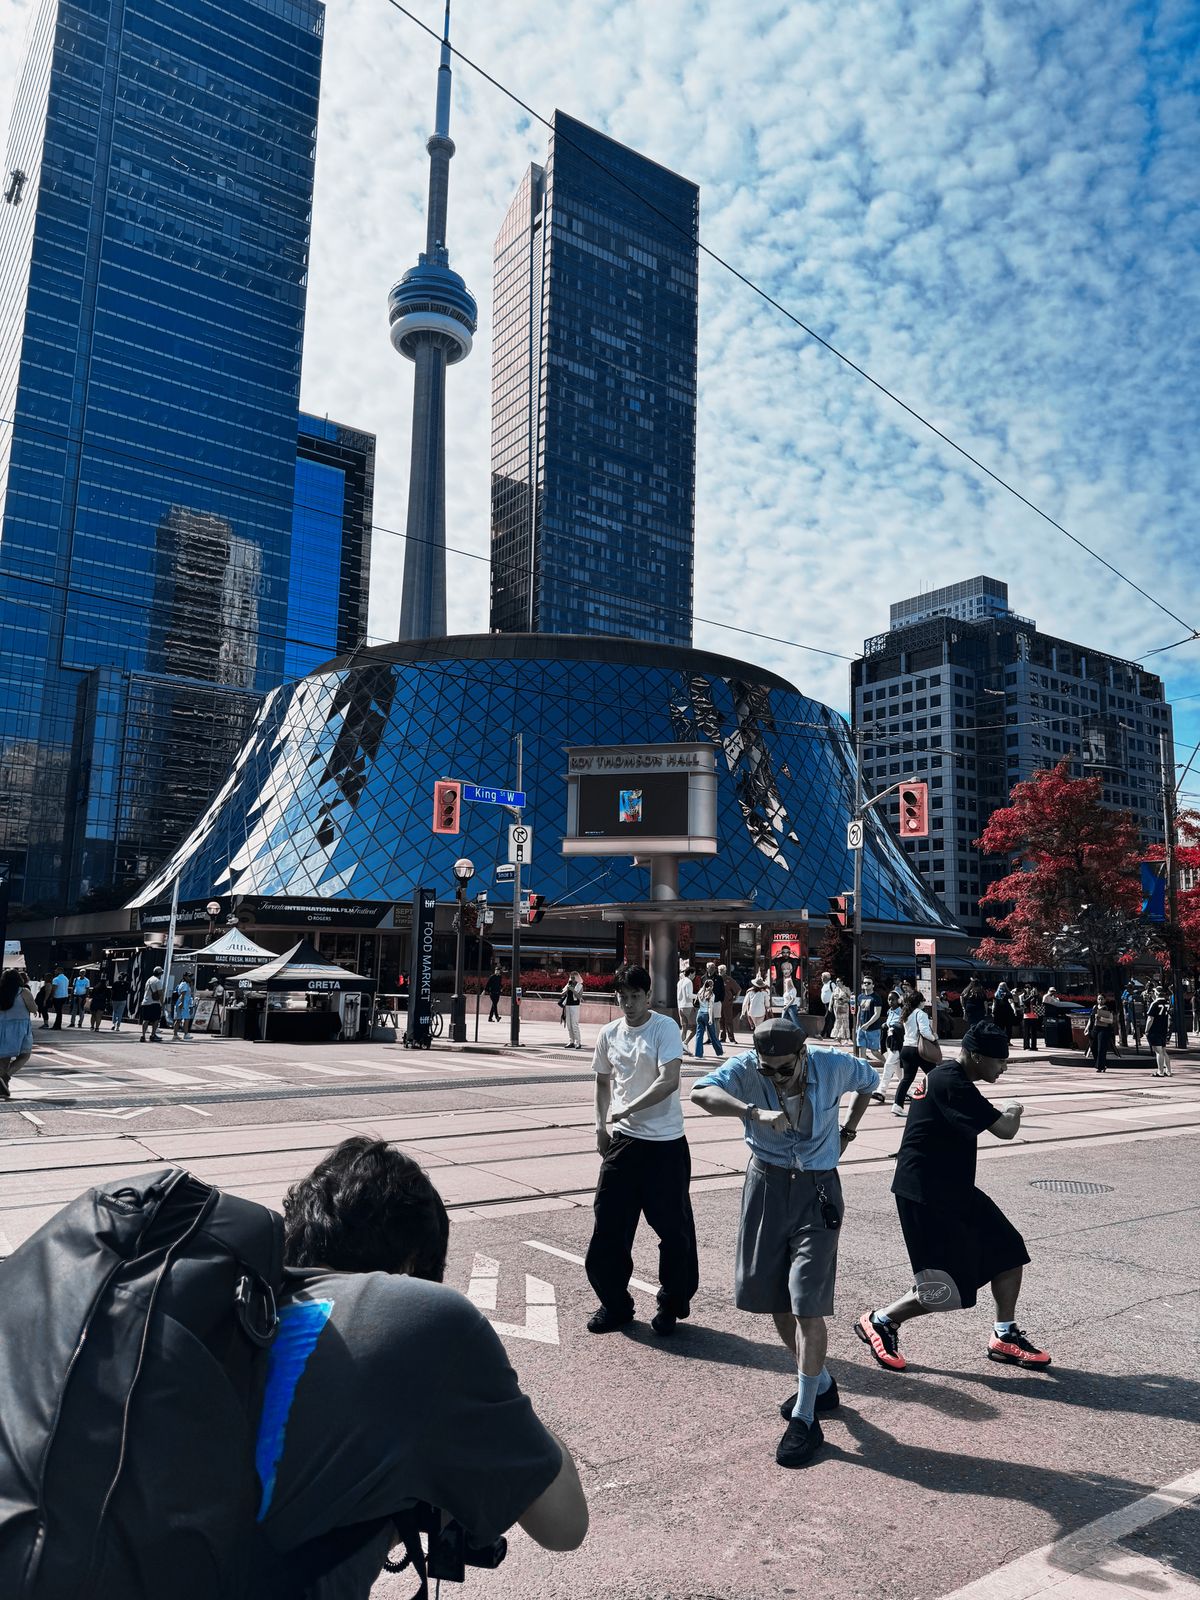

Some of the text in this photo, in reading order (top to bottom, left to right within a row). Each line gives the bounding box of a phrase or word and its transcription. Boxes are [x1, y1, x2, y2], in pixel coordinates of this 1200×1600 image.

[570, 752, 700, 770] ROY THOMSON HALL
[475, 787, 497, 803] King
[507, 792, 515, 802] W
[424, 900, 435, 908] tiff
[284, 905, 340, 913] INTERNATIONAL
[420, 921, 434, 1002] FOOD MARKET
[307, 981, 341, 989] GRETA
[419, 1016, 430, 1024] tiff
